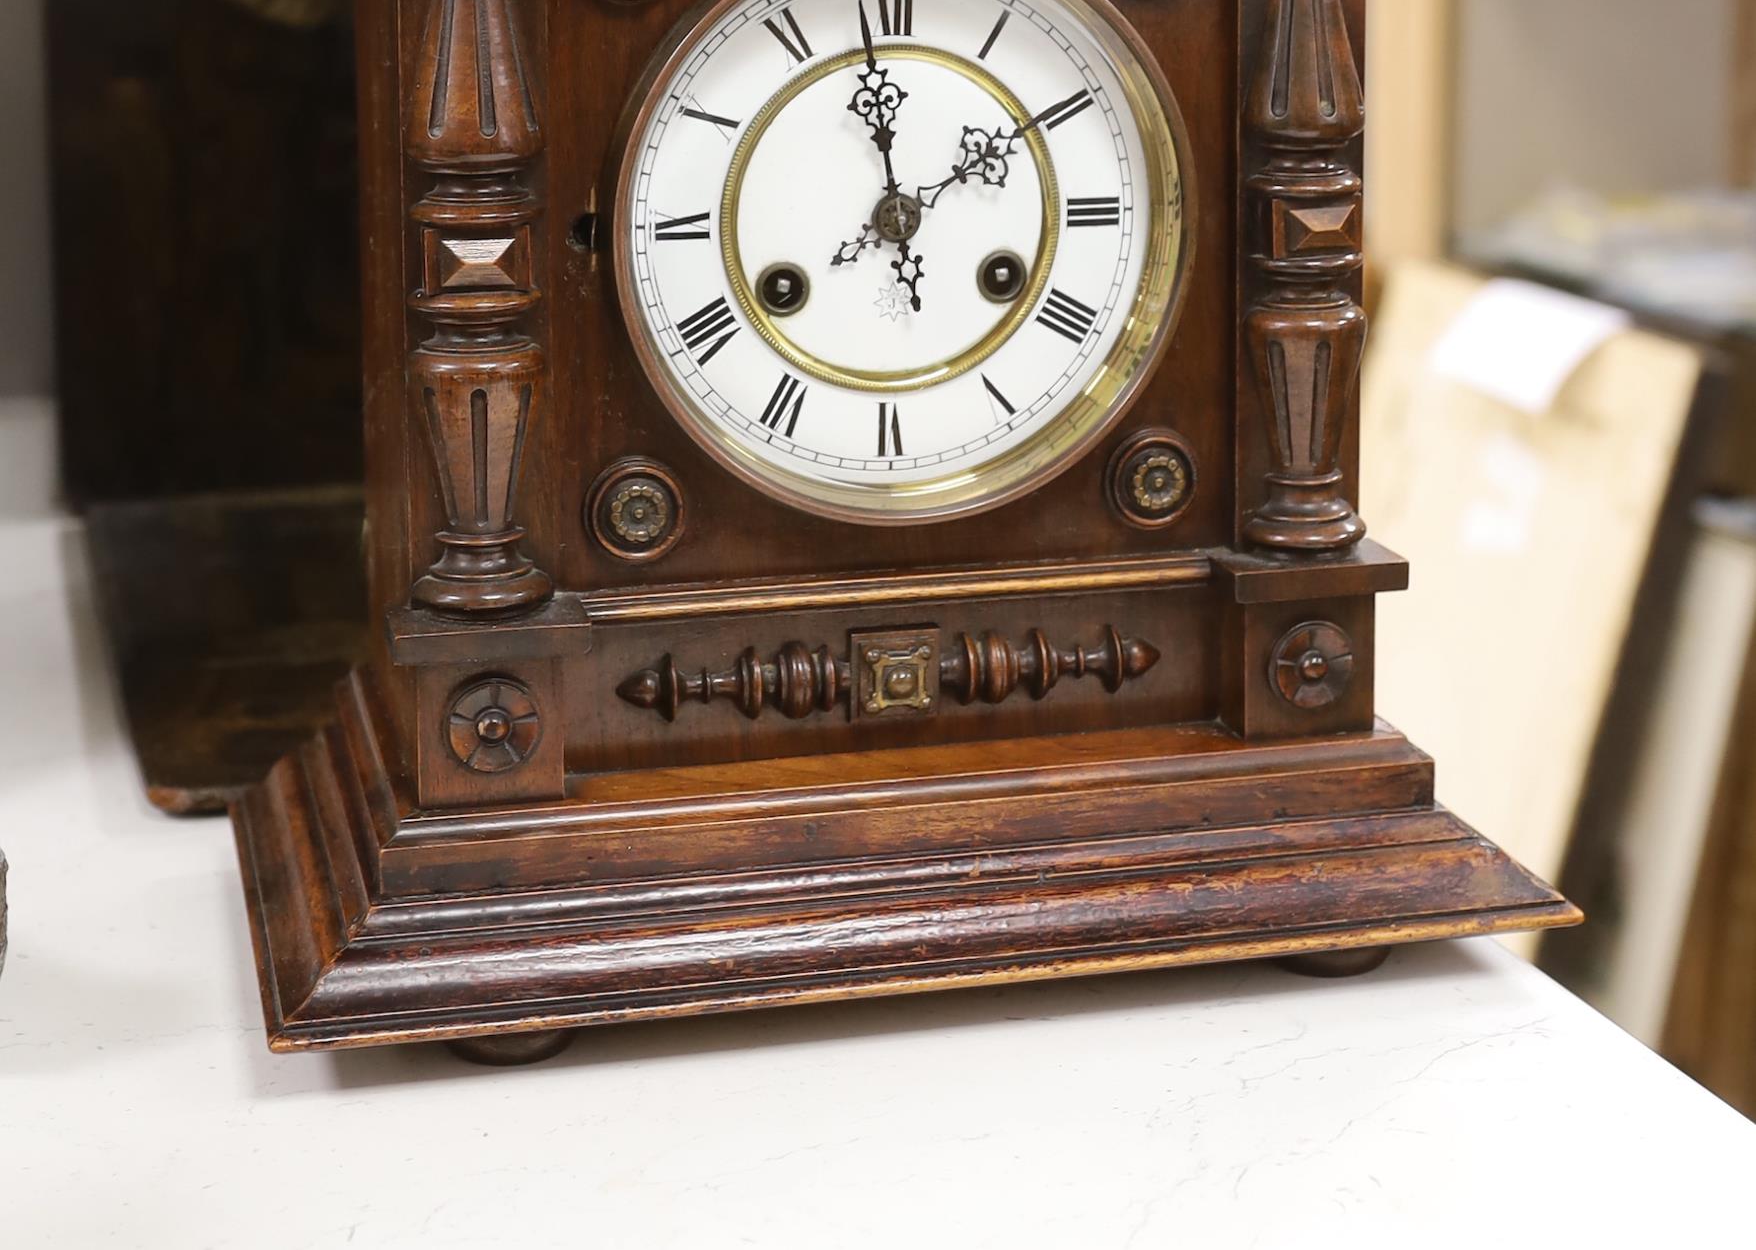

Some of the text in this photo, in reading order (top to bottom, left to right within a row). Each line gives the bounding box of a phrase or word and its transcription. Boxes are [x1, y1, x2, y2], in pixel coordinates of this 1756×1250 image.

[761, 5, 816, 71] XI
[977, 8, 1010, 60] I
[680, 93, 741, 142] X
[1041, 87, 1095, 131] II
[654, 210, 711, 241] IX
[1066, 196, 1120, 230] III
[676, 293, 742, 367] VIII
[1034, 286, 1099, 345] IIII
[758, 372, 808, 438] VII
[981, 372, 1017, 425] V
[876, 401, 904, 457] VI
